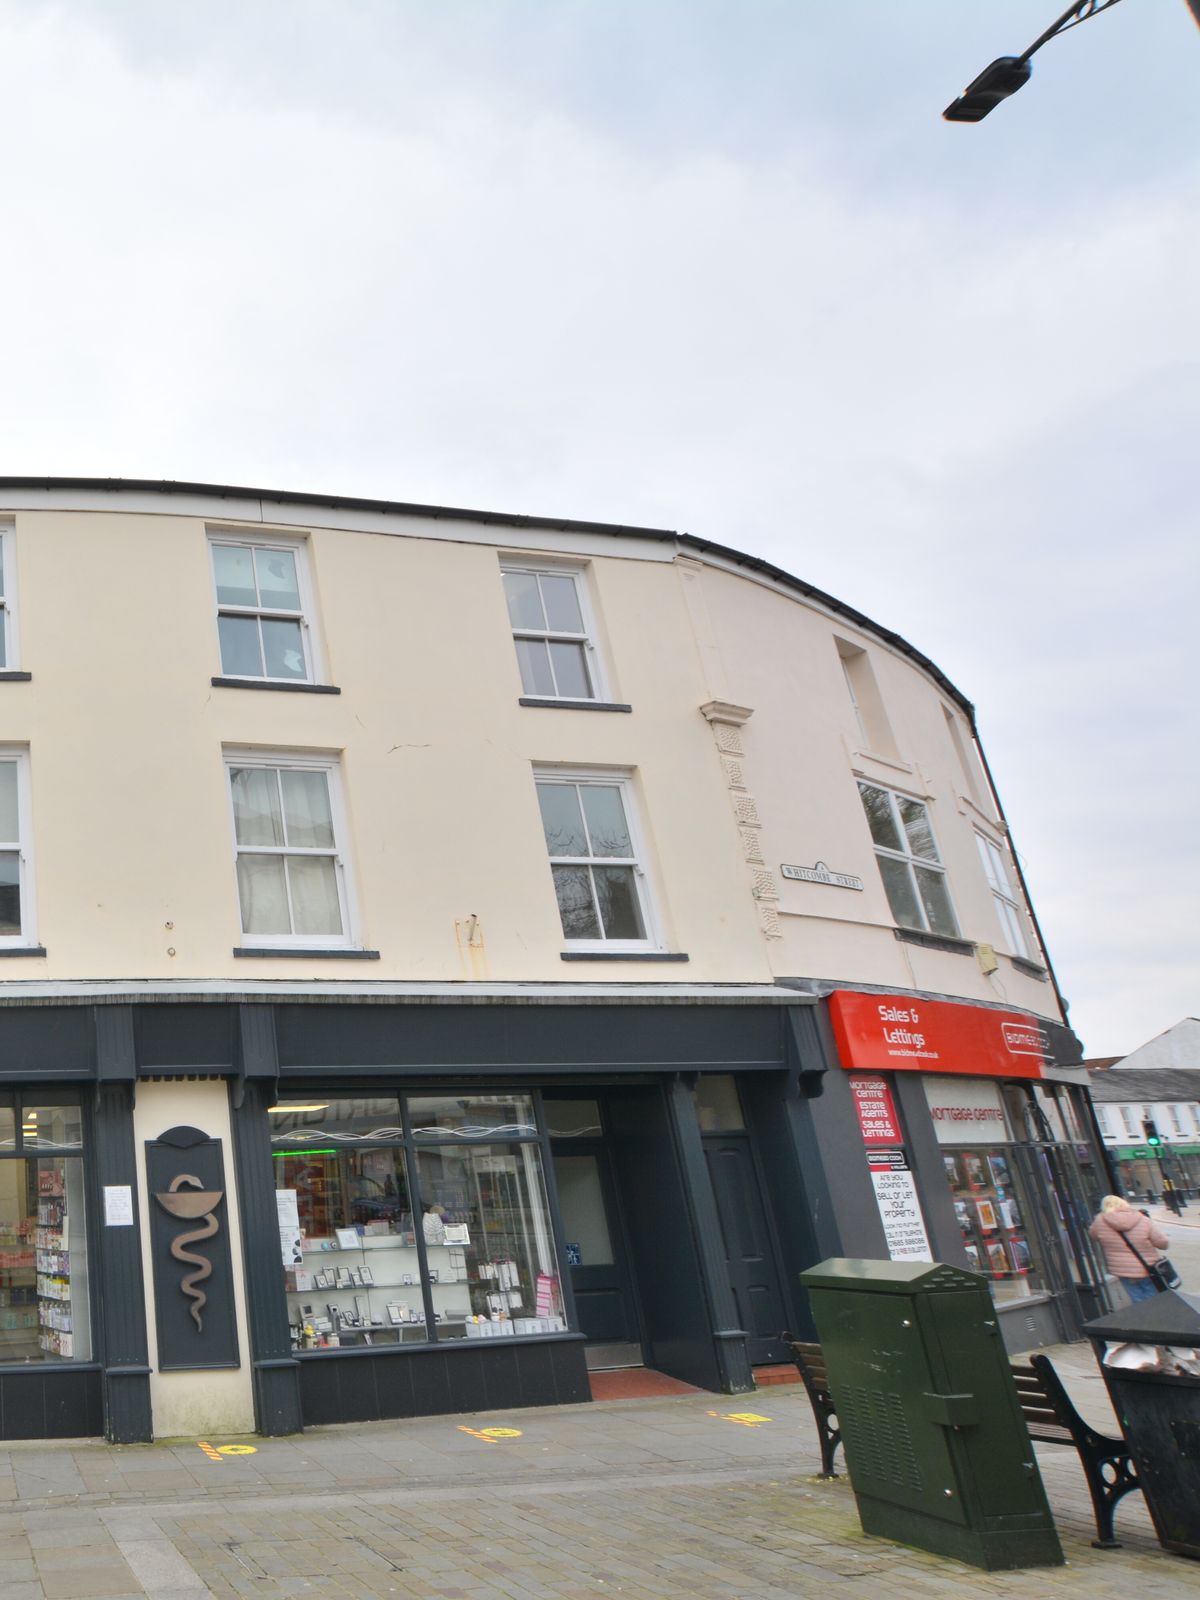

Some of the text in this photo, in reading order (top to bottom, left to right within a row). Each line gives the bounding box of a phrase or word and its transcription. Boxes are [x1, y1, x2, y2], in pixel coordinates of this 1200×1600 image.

[785, 867, 859, 888] WHITCOMBE STREET
[878, 1005, 918, 1023] Sales &
[883, 1027, 925, 1048] Lettings
